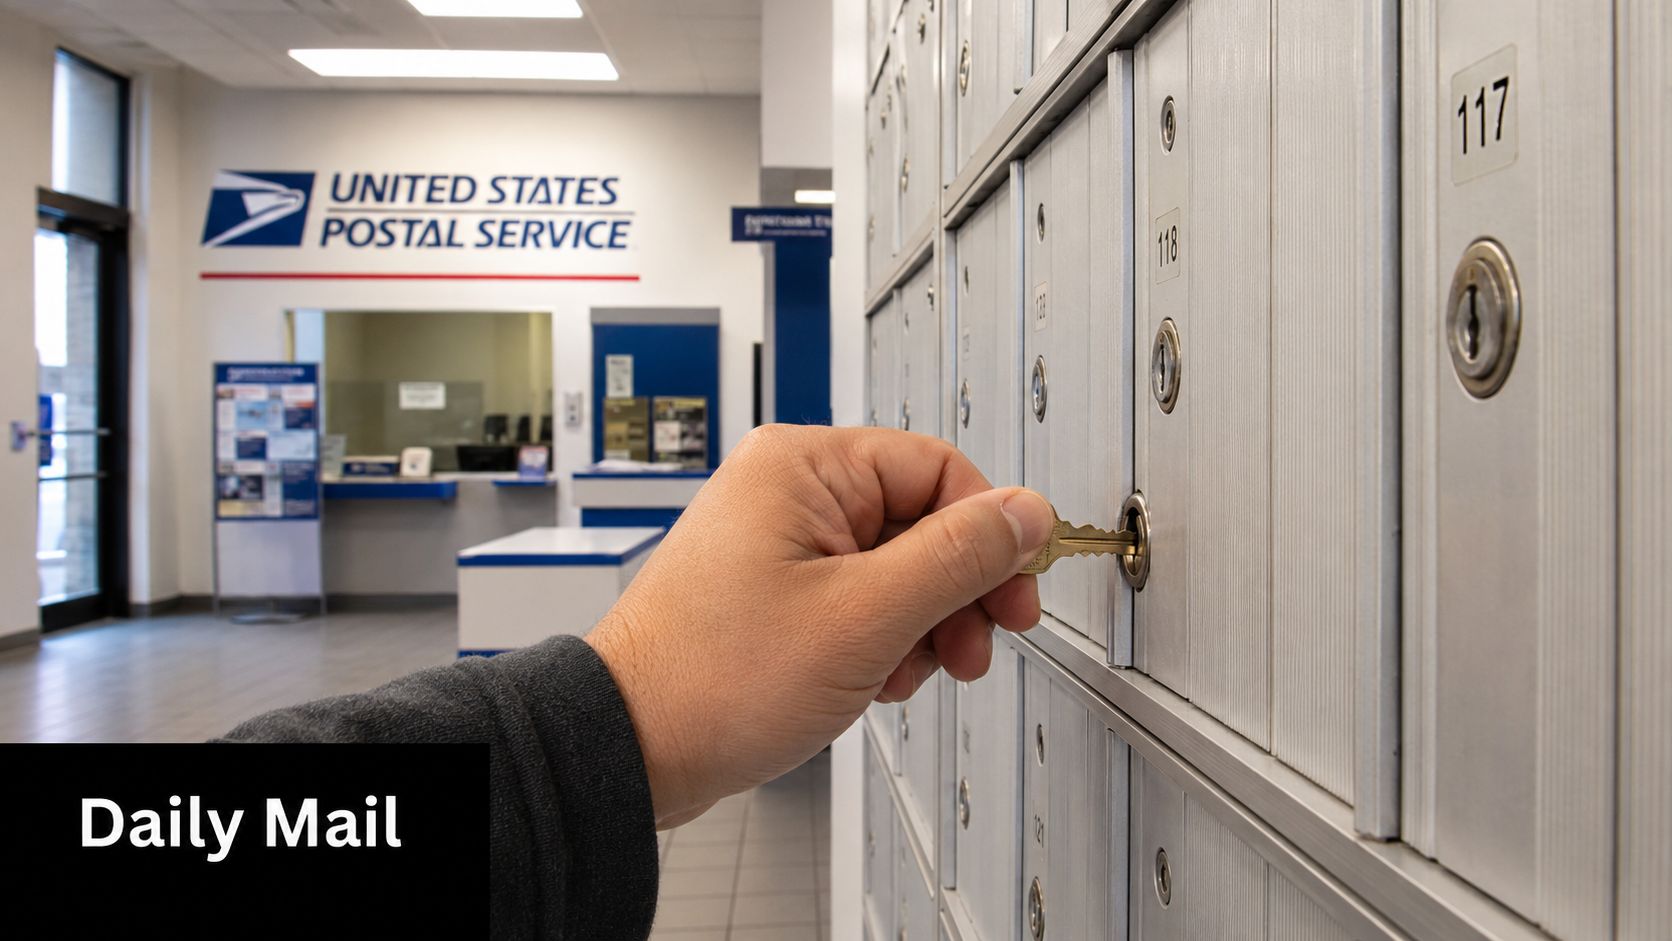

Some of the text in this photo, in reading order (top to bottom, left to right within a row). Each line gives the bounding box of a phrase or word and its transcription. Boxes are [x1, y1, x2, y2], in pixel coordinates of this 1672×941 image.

[1457, 76, 1510, 155] 117
[330, 173, 619, 205] UNITED STATES
[320, 217, 631, 249] POSTAL SERVICE
[1158, 225, 1178, 267] 118
